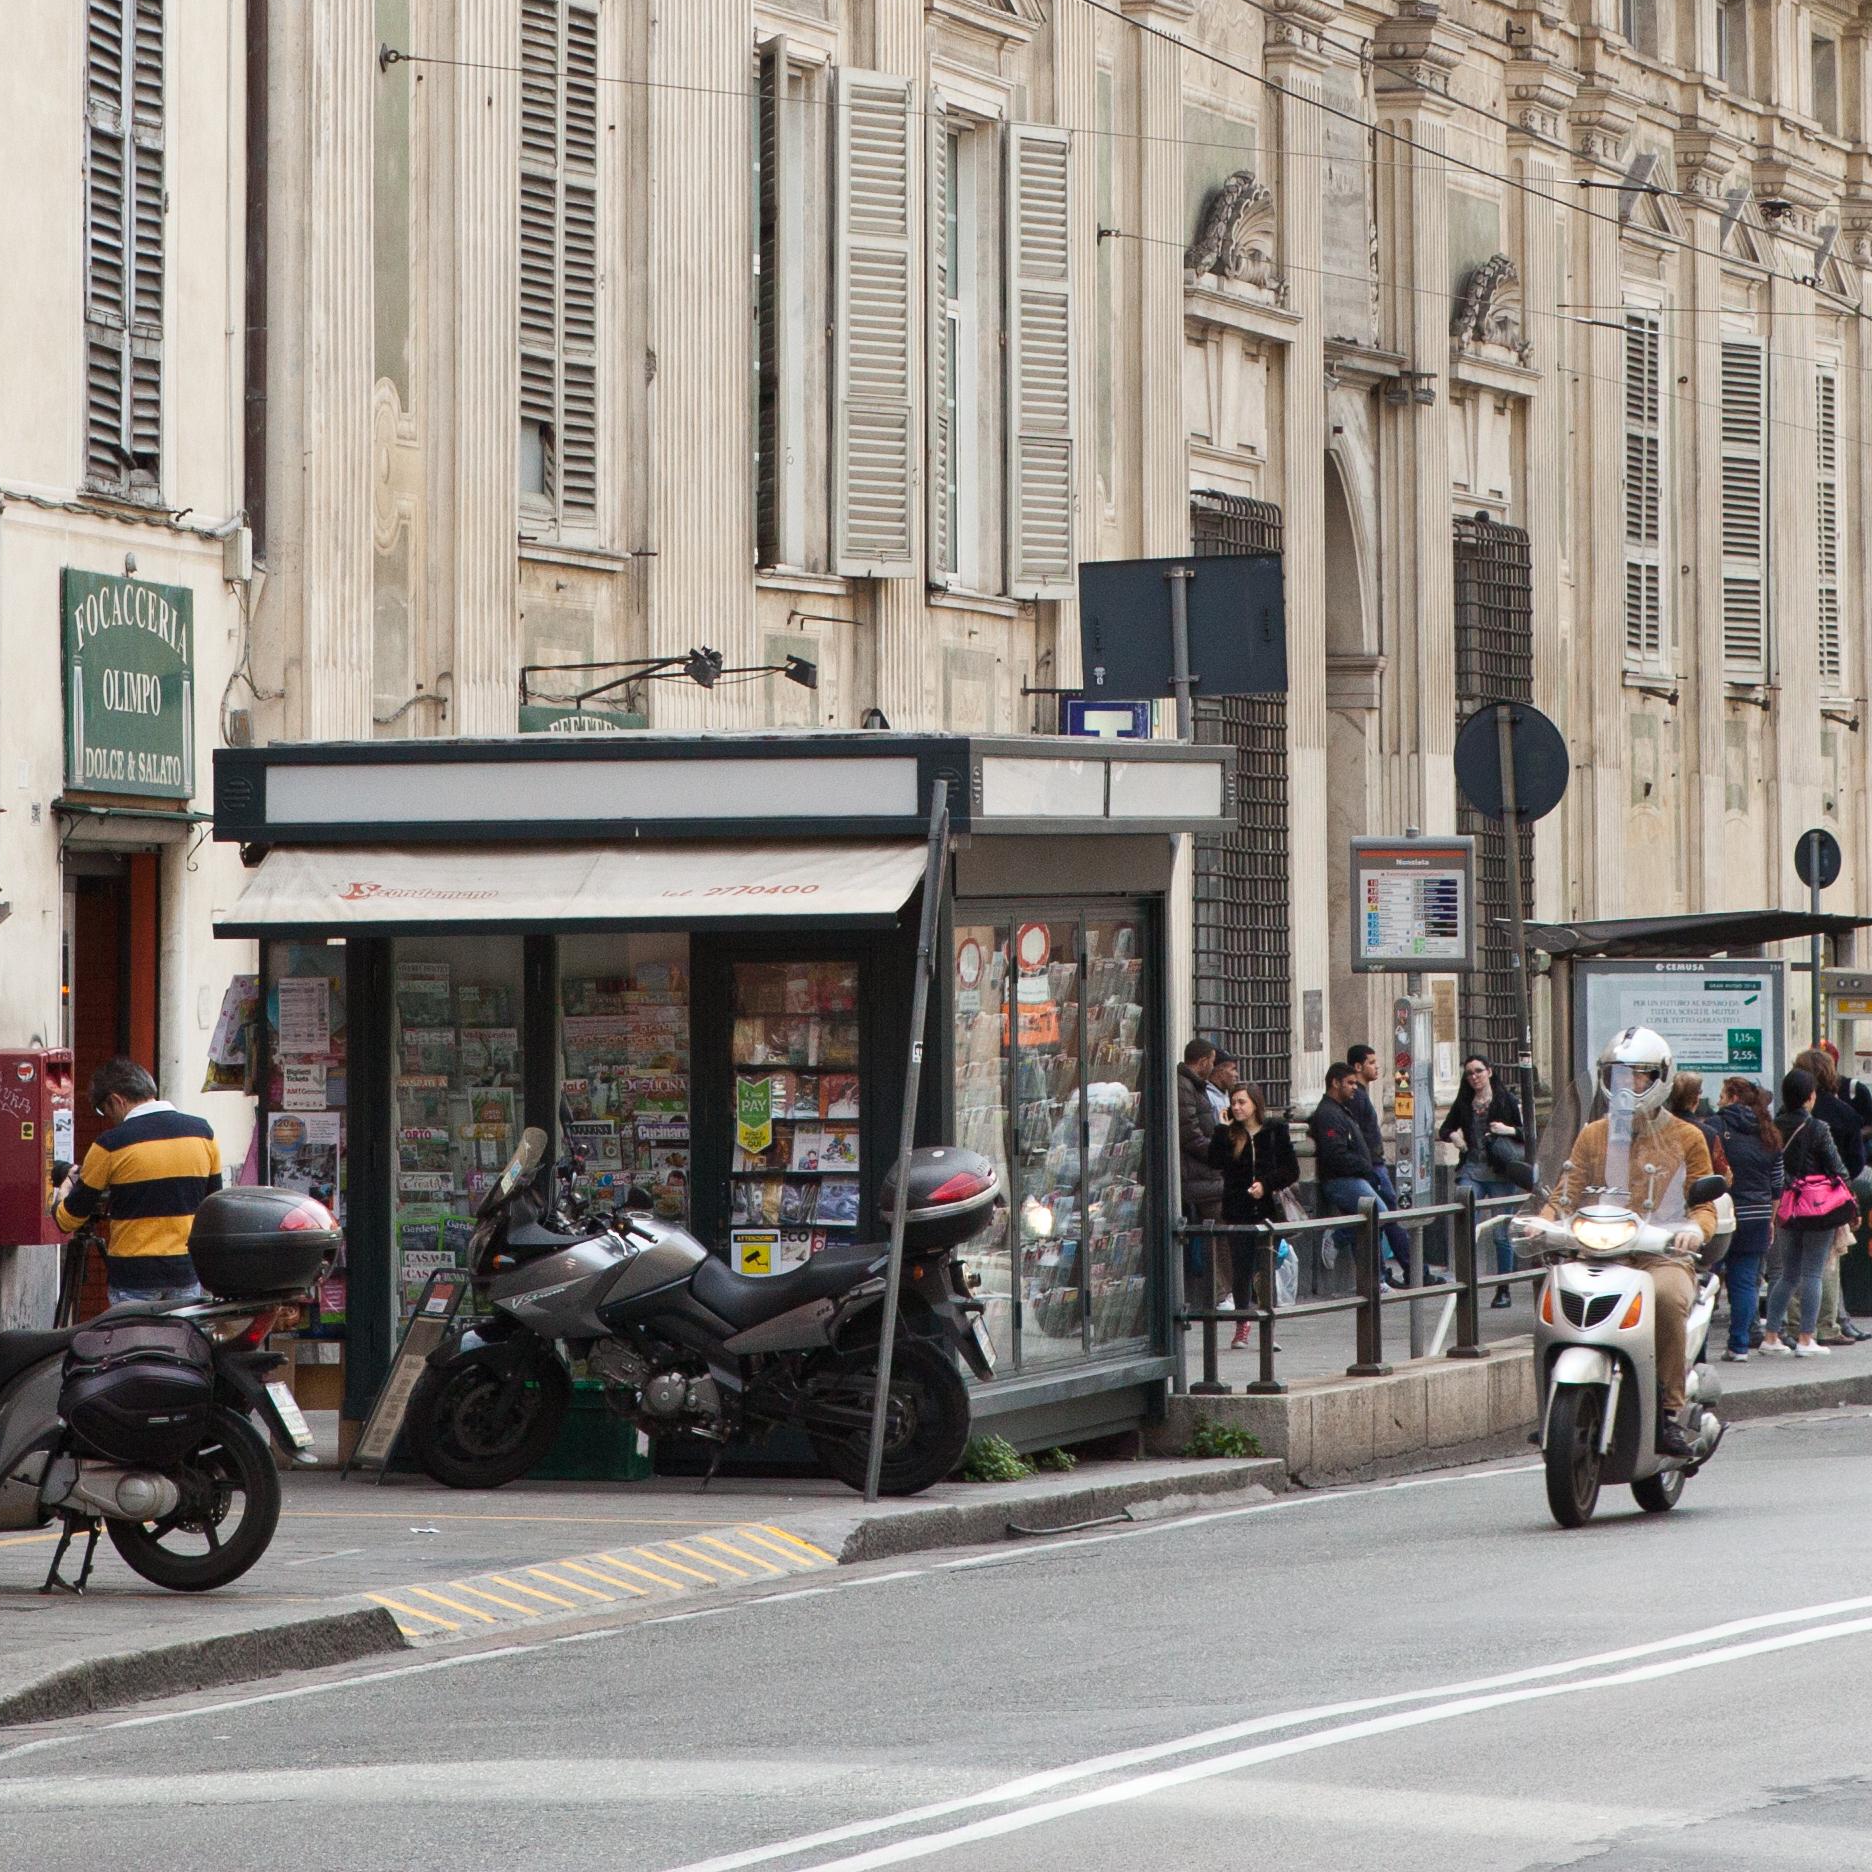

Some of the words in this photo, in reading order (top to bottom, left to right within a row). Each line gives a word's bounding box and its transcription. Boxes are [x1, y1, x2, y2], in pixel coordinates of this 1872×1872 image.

[74, 584, 188, 665] FOCACCERIA
[102, 668, 161, 716] OLIMPO
[85, 747, 124, 781] DOLCE
[127, 750, 136, 782] &
[138, 752, 181, 786] SALATO
[702, 884, 820, 897] 2770400
[1665, 963, 1705, 971] CEMUSA
[741, 1099, 768, 1112] PAY
